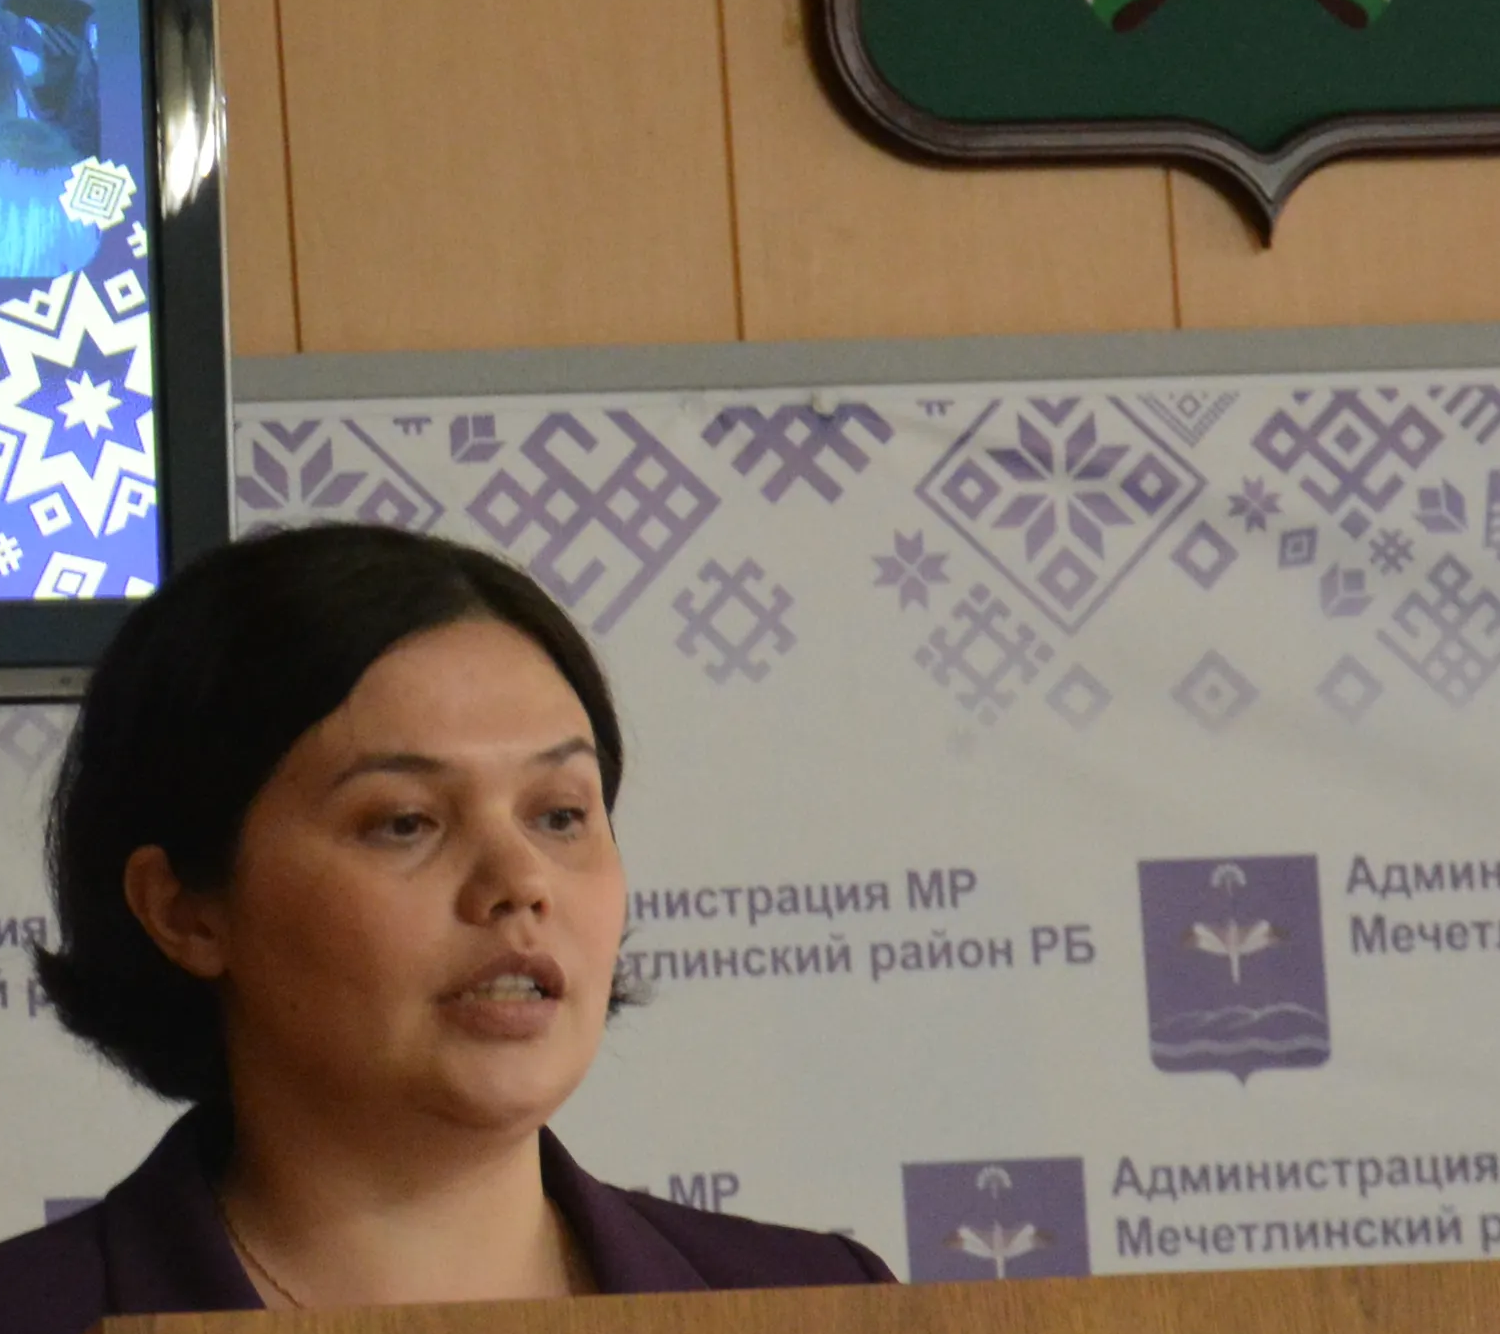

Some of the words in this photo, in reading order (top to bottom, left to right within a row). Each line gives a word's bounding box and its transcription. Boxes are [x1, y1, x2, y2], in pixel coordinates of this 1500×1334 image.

[623, 878, 891, 926] нистрация
[907, 867, 978, 909] МР
[871, 929, 1014, 981] район
[1031, 924, 1095, 965] РБ
[1112, 1152, 1498, 1200] Администрация
[1115, 1205, 1461, 1257] Мечетлинский
